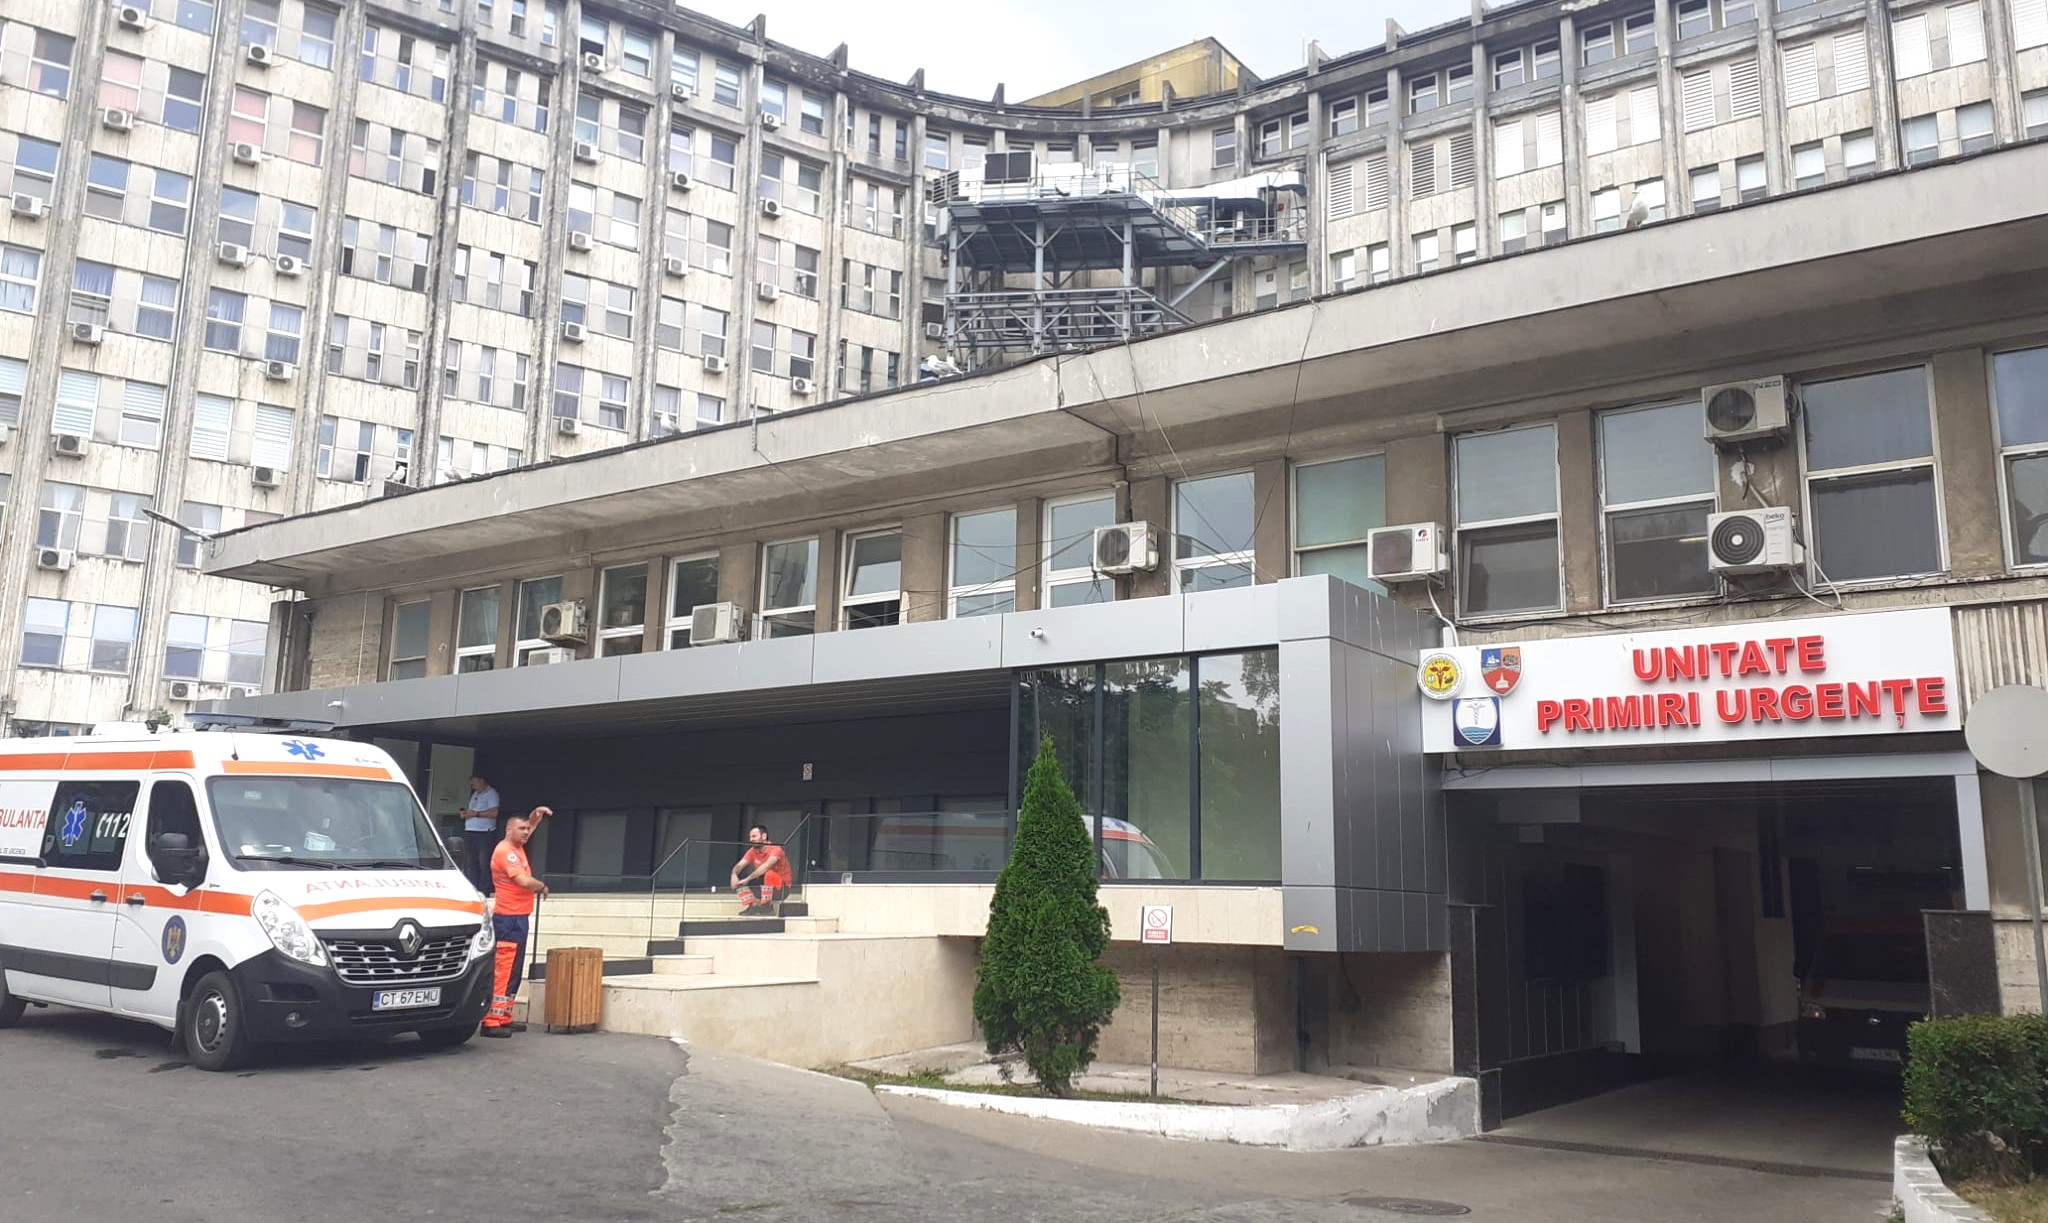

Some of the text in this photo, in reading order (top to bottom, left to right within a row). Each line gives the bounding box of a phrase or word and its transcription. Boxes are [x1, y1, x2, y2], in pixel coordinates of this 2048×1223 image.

[1632, 635, 1826, 682] UNITATE
[1537, 692, 1701, 734] PRIMIRI
[104, 813, 131, 838] 112
[381, 993, 397, 1006] CT
